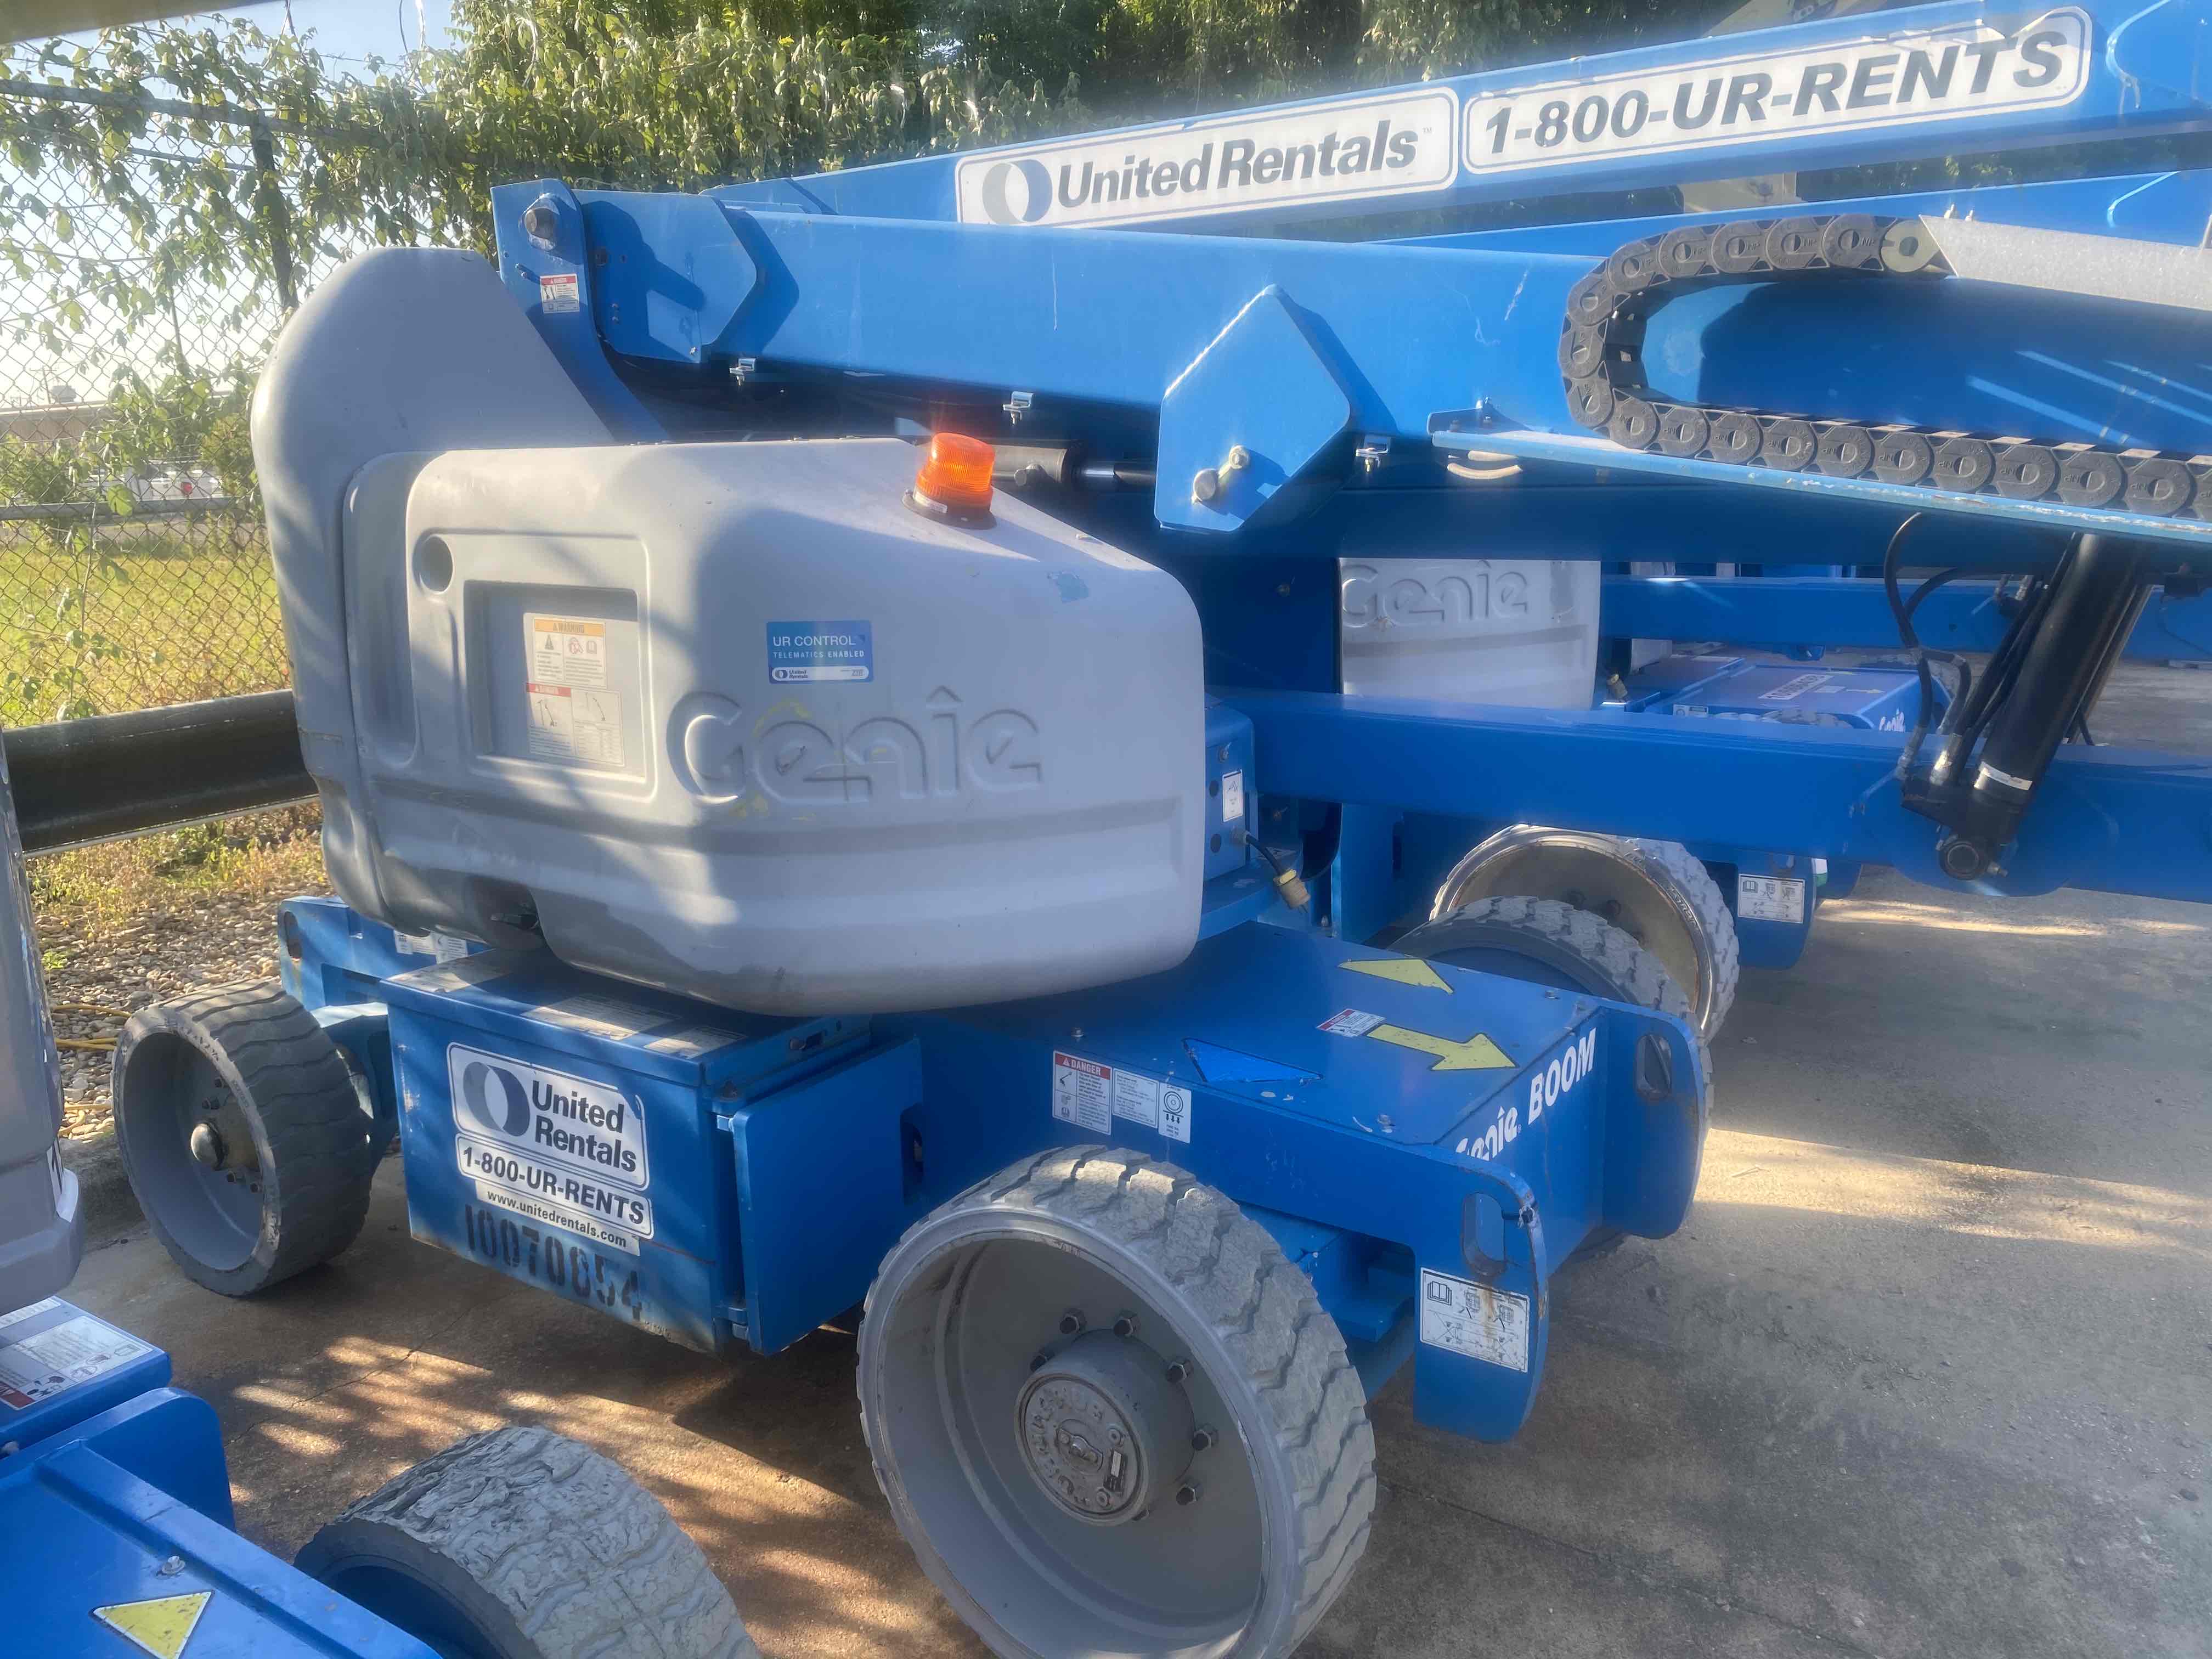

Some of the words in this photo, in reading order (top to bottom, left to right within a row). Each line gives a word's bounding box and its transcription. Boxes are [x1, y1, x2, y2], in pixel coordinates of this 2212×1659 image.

[1486, 31, 2067, 154] 1-800-UR-RENTS
[1058, 143, 1212, 208] United
[1217, 120, 1419, 189] Rentals
[1342, 560, 1528, 627] Genie
[772, 636, 791, 647] UR
[794, 635, 856, 646] CONTROL
[773, 651, 823, 659] TELEMATICS
[828, 650, 865, 658] ENABLED
[665, 685, 1042, 805] Genie
[1070, 1059, 1101, 1076] DANGER
[1528, 1026, 1596, 1125] BOOM
[531, 1079, 624, 1133] United
[534, 1115, 636, 1173] Rentals
[463, 1146, 644, 1225] 1-800-UR-RENTS
[487, 1189, 627, 1249] www.unitedrentals.com
